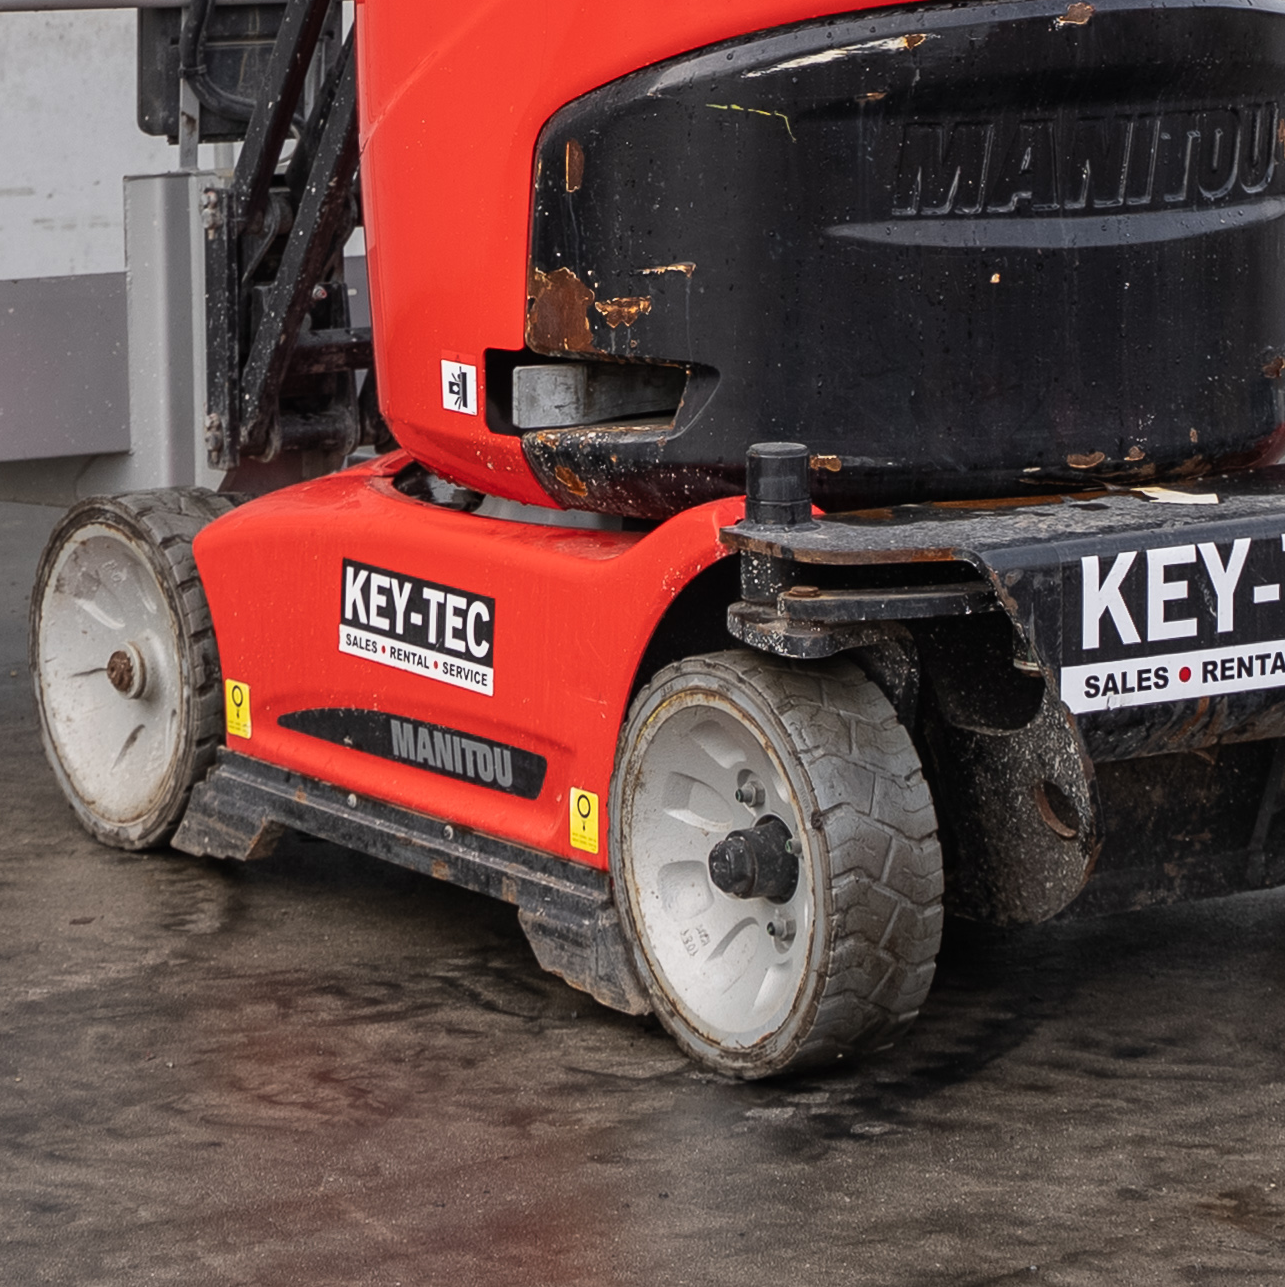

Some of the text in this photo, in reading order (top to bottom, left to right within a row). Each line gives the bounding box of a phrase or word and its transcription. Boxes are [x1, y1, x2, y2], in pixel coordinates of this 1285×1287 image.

[891, 101, 1280, 215] MANITOU
[344, 565, 491, 659] KEY-TEC
[345, 633, 488, 687] SALES RENTAL SERVICE
[1083, 665, 1170, 699] SALES
[390, 718, 514, 788] MANITOU
